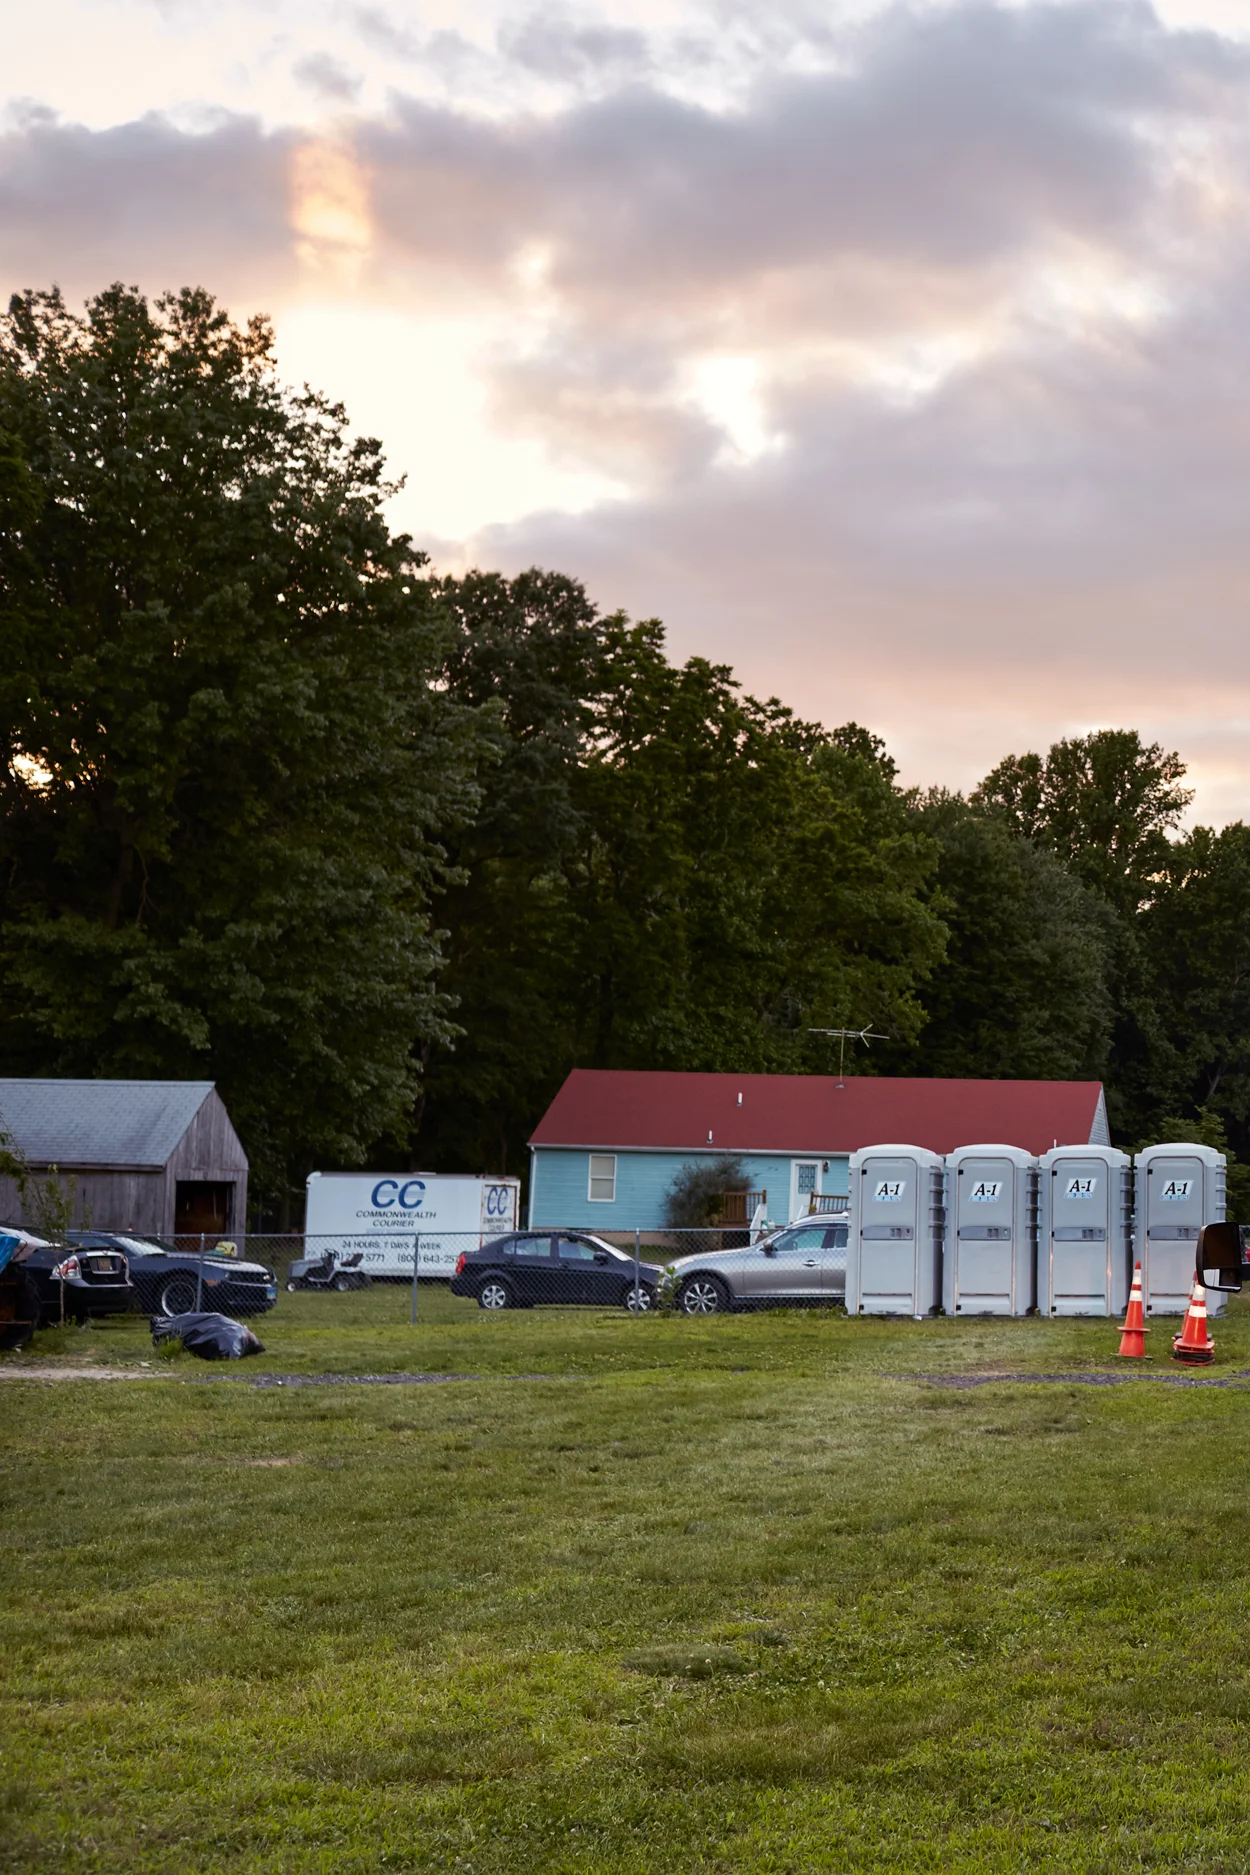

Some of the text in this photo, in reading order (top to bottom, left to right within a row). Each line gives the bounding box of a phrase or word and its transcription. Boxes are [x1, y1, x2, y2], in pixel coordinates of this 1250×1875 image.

[878, 1183, 900, 1195] A-1
[974, 1183, 997, 1195] A-1
[1069, 1179, 1092, 1192] A-1
[1165, 1182, 1188, 1194] A-1
[371, 1179, 426, 1209] CC
[487, 1187, 508, 1215] CC
[356, 1210, 437, 1219] COMMONWEALTH
[373, 1219, 415, 1227] COURIER
[391, 1241, 409, 1249] DAYS
